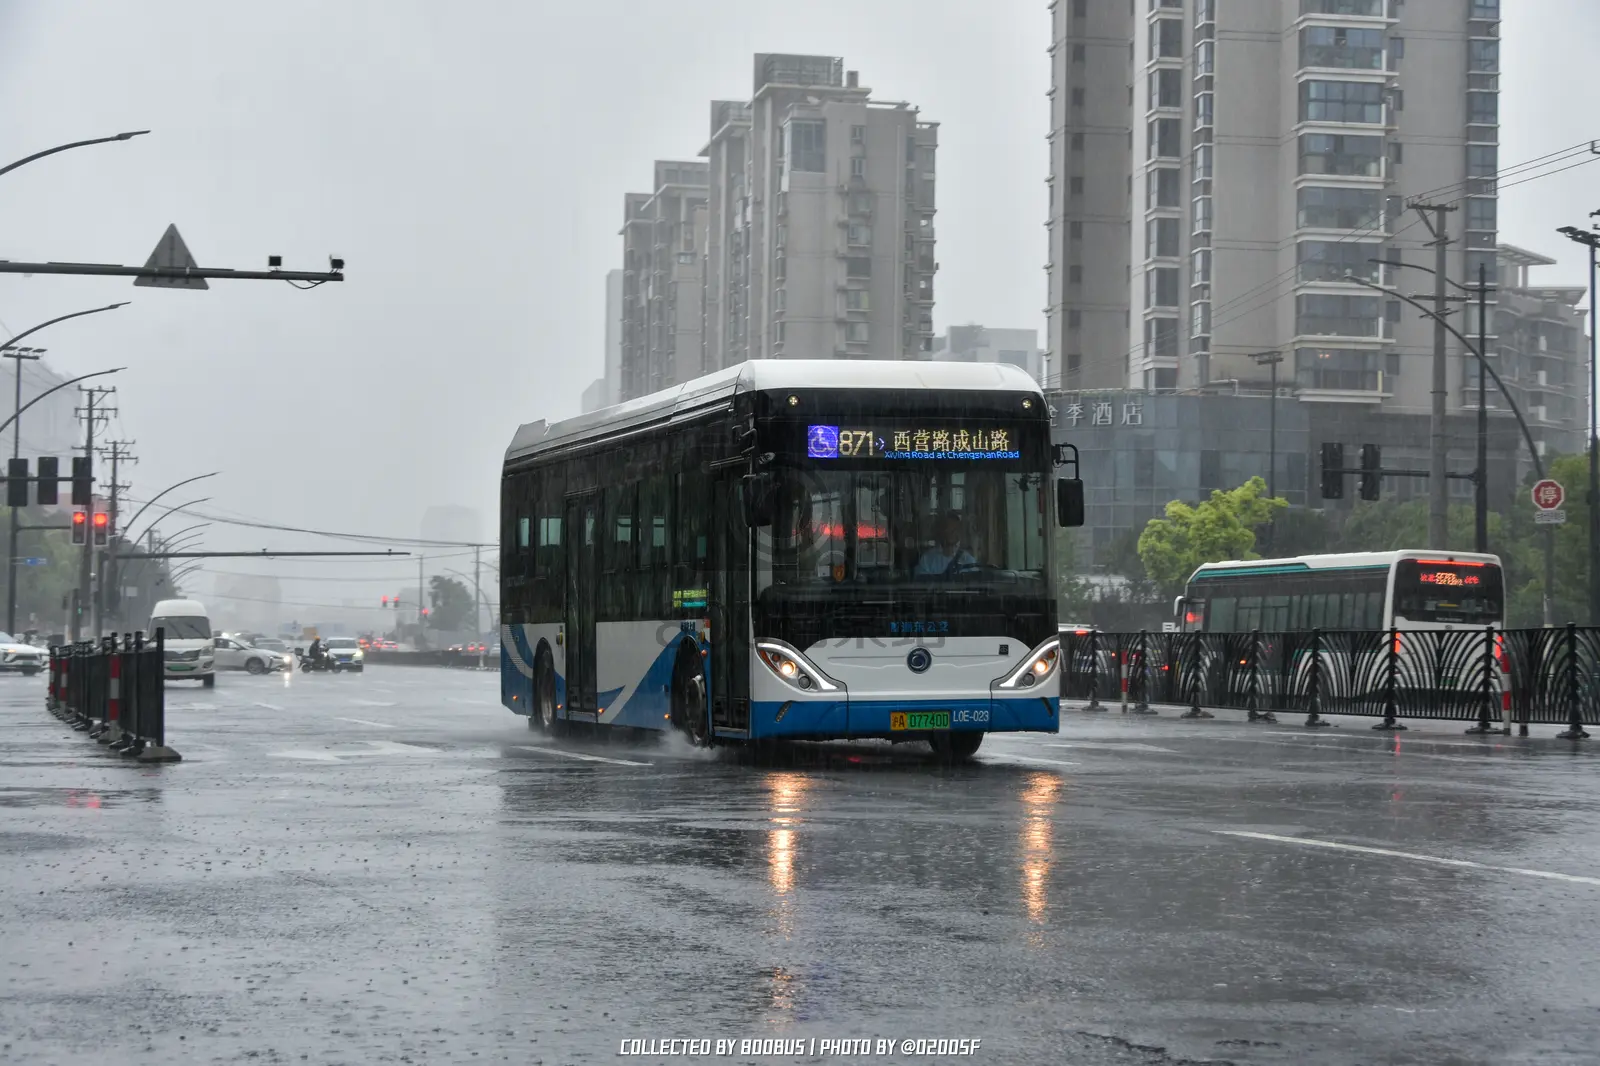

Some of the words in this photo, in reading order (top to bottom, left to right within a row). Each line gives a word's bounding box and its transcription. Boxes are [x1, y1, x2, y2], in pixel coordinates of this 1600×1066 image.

[839, 430, 874, 456] 871
[893, 429, 1010, 452] 西营路成山路
[911, 451, 935, 459] Road
[936, 451, 947, 459] at
[1538, 486, 1557, 504] 停
